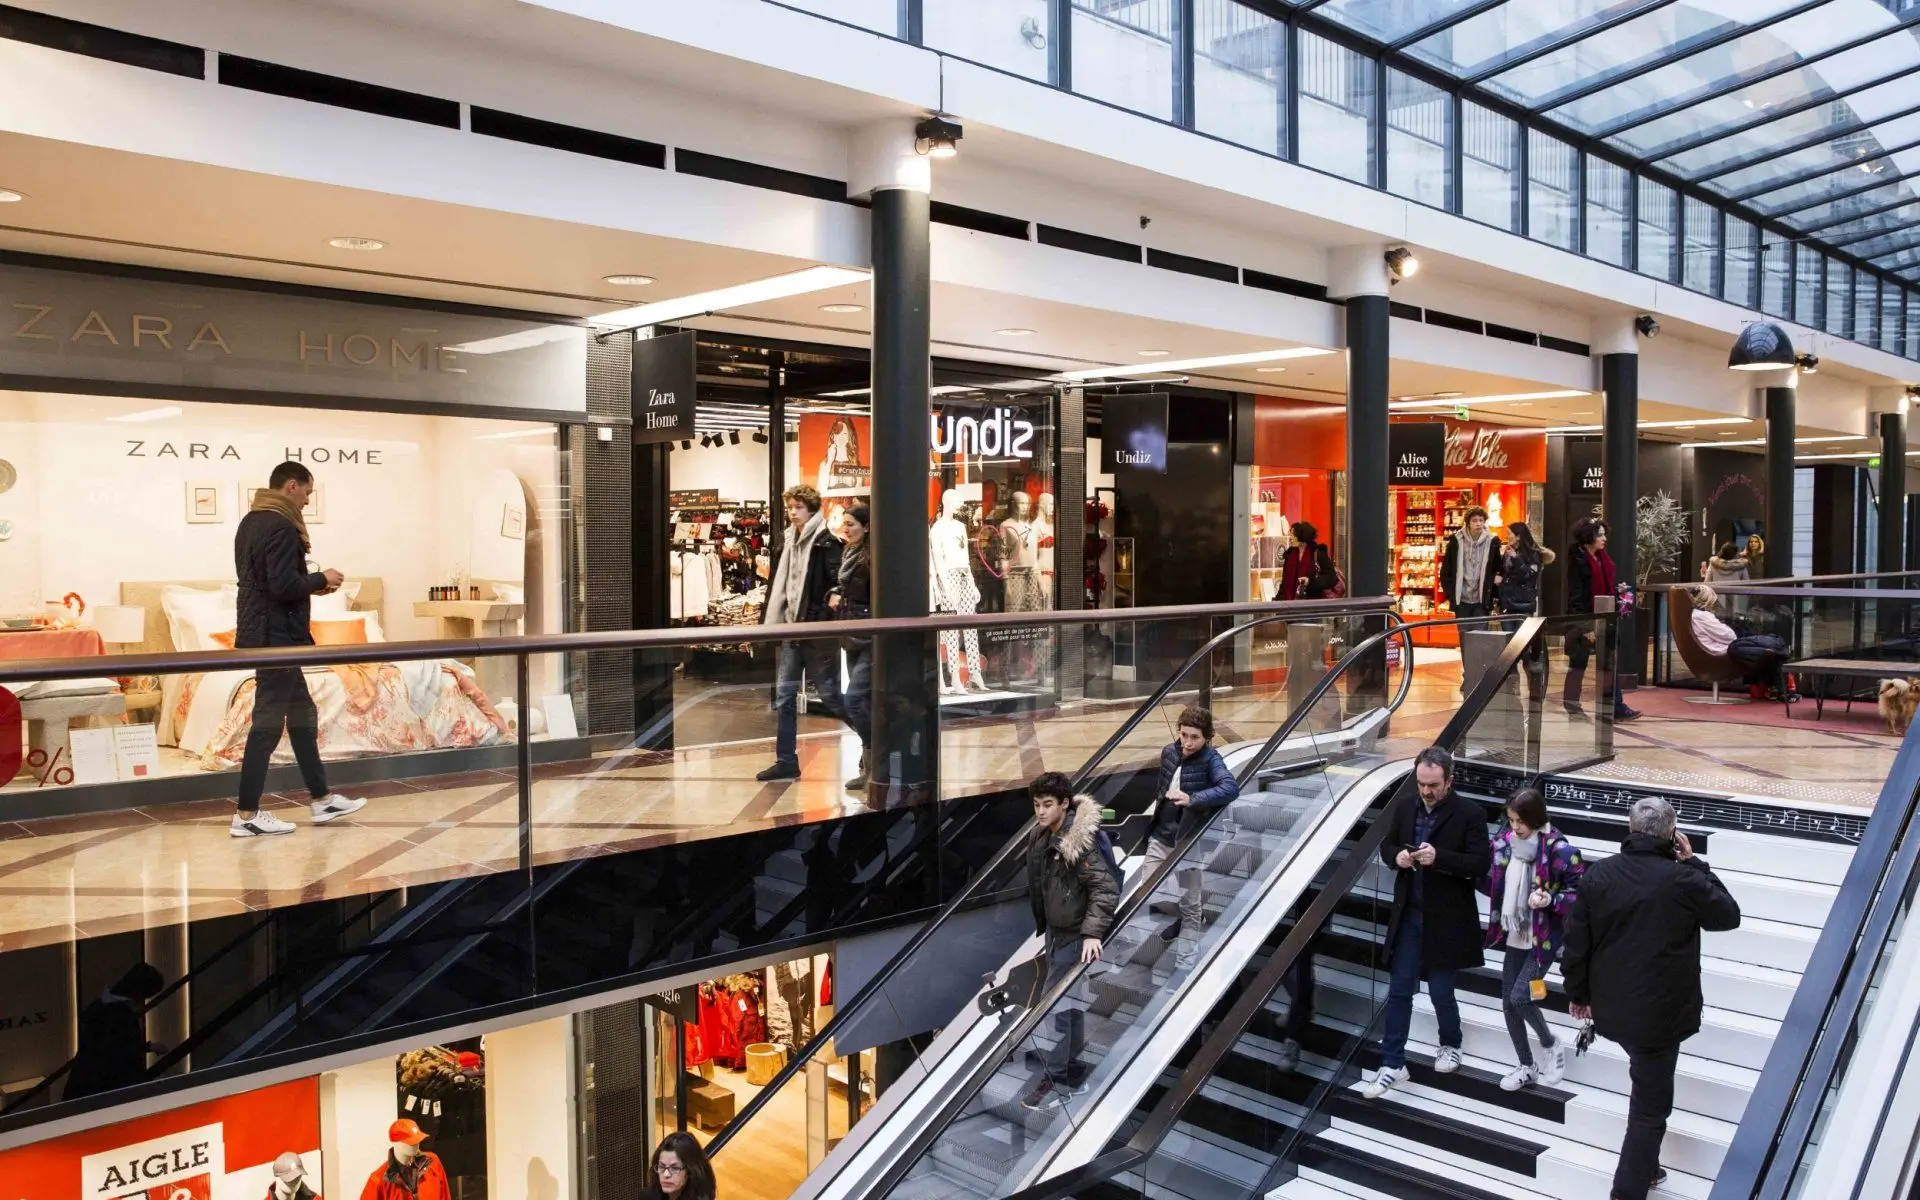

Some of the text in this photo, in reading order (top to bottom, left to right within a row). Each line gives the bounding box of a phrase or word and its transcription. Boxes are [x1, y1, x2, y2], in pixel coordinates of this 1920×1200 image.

[12, 303, 467, 374] ZARA HOME
[648, 388, 676, 407] Zara
[645, 411, 679, 430] Home
[930, 407, 1034, 458] undiz
[126, 440, 382, 465] ZARA HOME
[1444, 422, 1468, 467] lice
[1115, 450, 1152, 464] Undiz
[1399, 453, 1428, 465] Alice
[838, 467, 872, 475] #CrazyInLo
[1396, 466, 1431, 478] Délice
[1585, 467, 1603, 477] Ali
[1582, 478, 1604, 489] Déli
[26, 746, 74, 787] %
[98, 1141, 209, 1193] AIGLE
